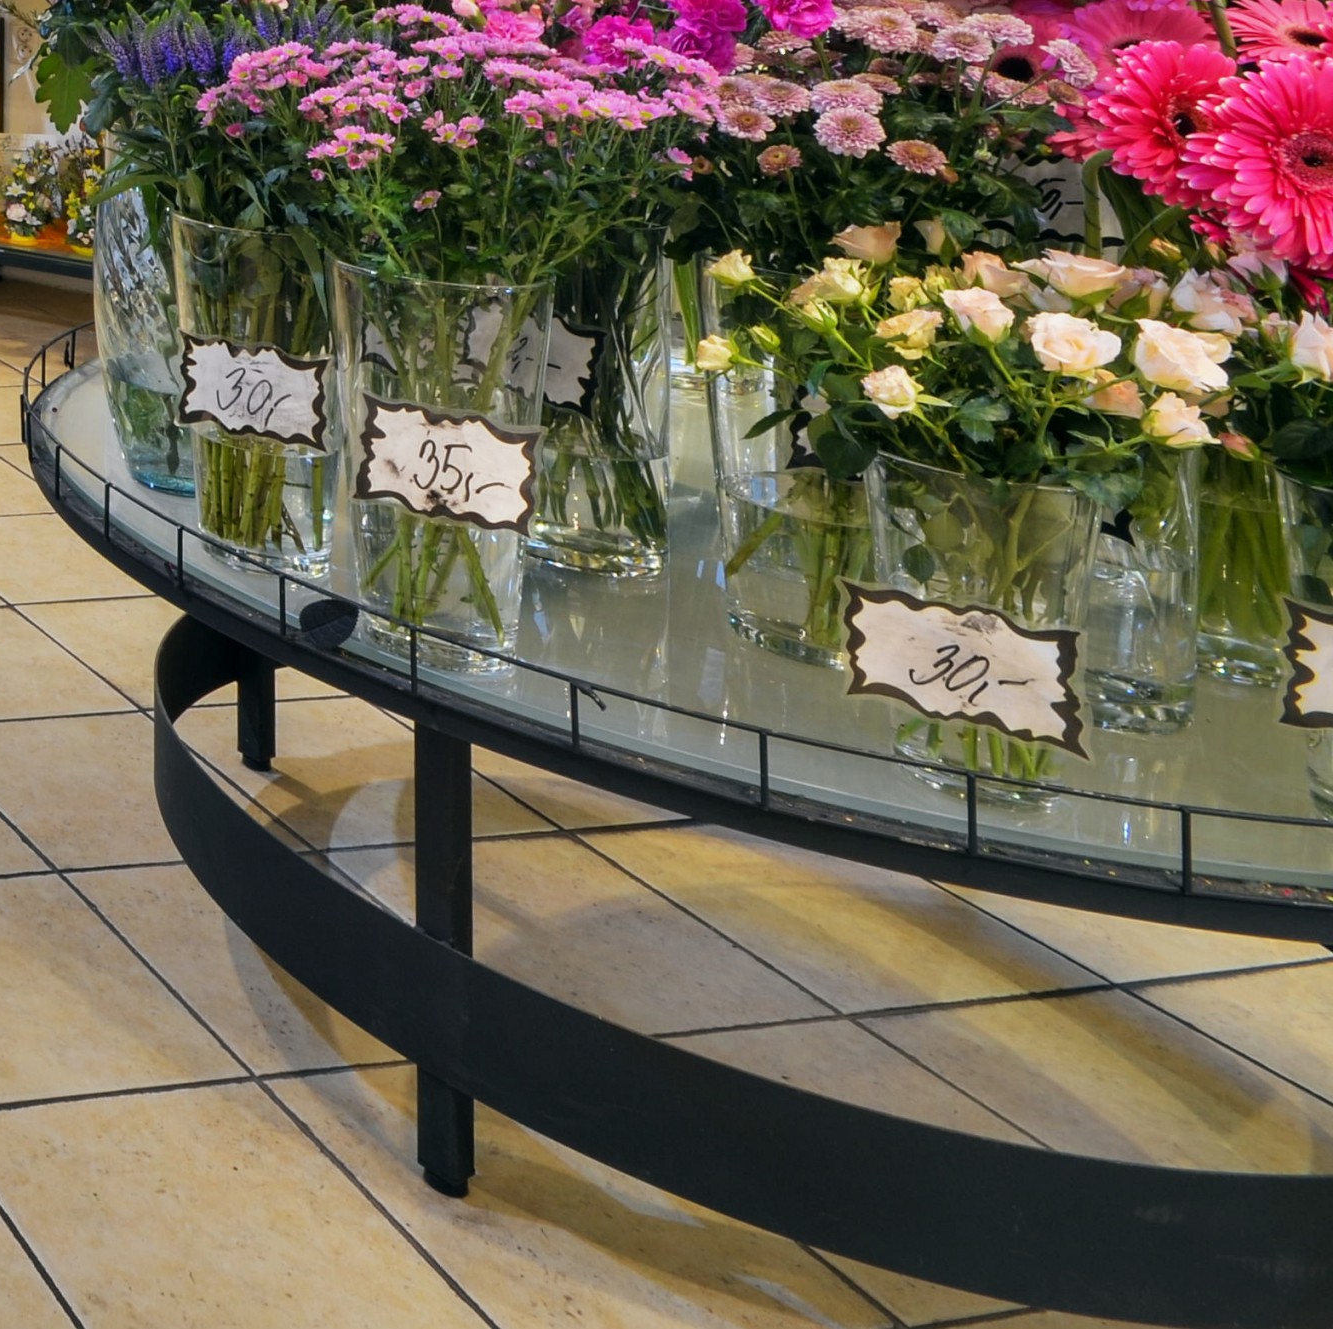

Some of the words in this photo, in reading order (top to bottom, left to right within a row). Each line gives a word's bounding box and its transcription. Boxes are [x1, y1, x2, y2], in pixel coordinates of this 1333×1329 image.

[216, 367, 292, 427] 30,-
[413, 439, 513, 502] 35,-
[909, 644, 1036, 704] 30,-
